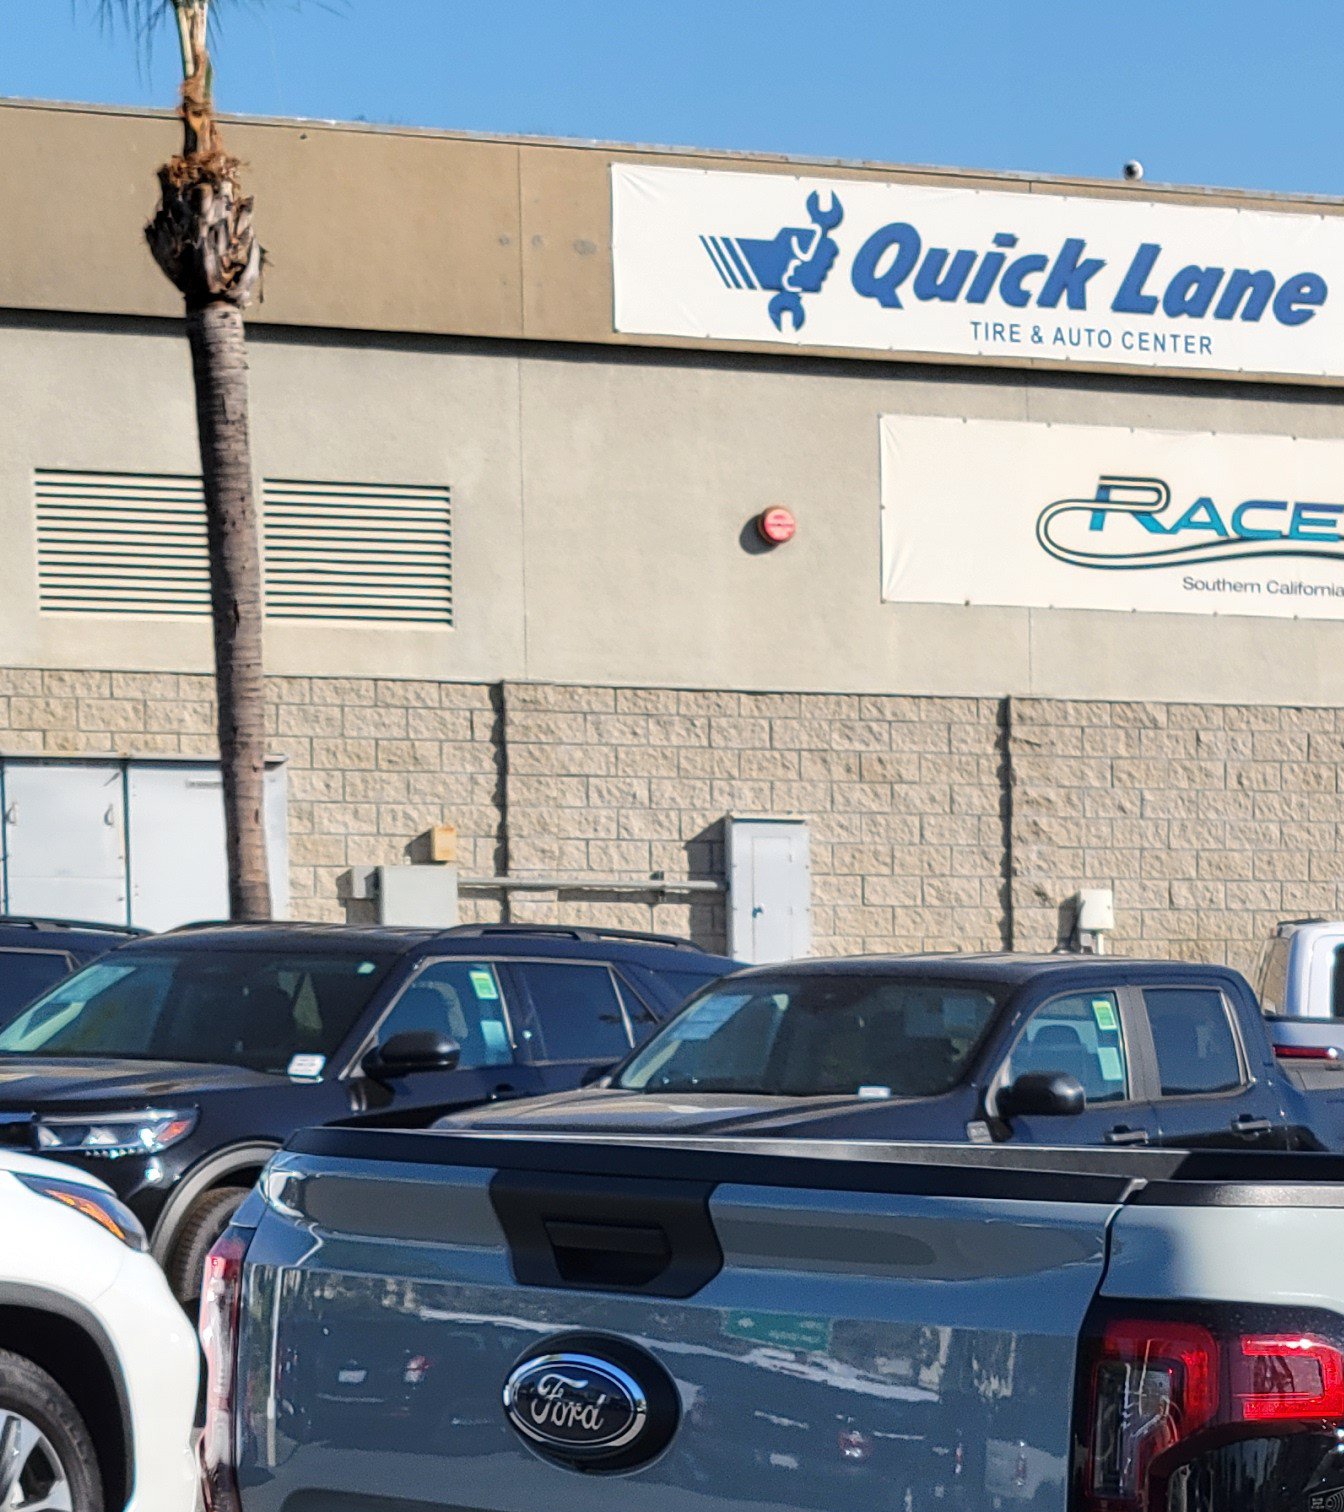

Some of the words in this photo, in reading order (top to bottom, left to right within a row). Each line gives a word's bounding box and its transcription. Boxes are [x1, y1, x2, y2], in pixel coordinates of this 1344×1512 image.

[850, 221, 1107, 310] Quick
[1111, 242, 1328, 327] Lane
[969, 321, 1021, 344] TIRE
[1030, 324, 1044, 344] &
[1052, 326, 1113, 350] AUTO
[1121, 331, 1213, 355] CENTER
[1182, 576, 1261, 595] Southern
[530, 1372, 606, 1431] Ford
